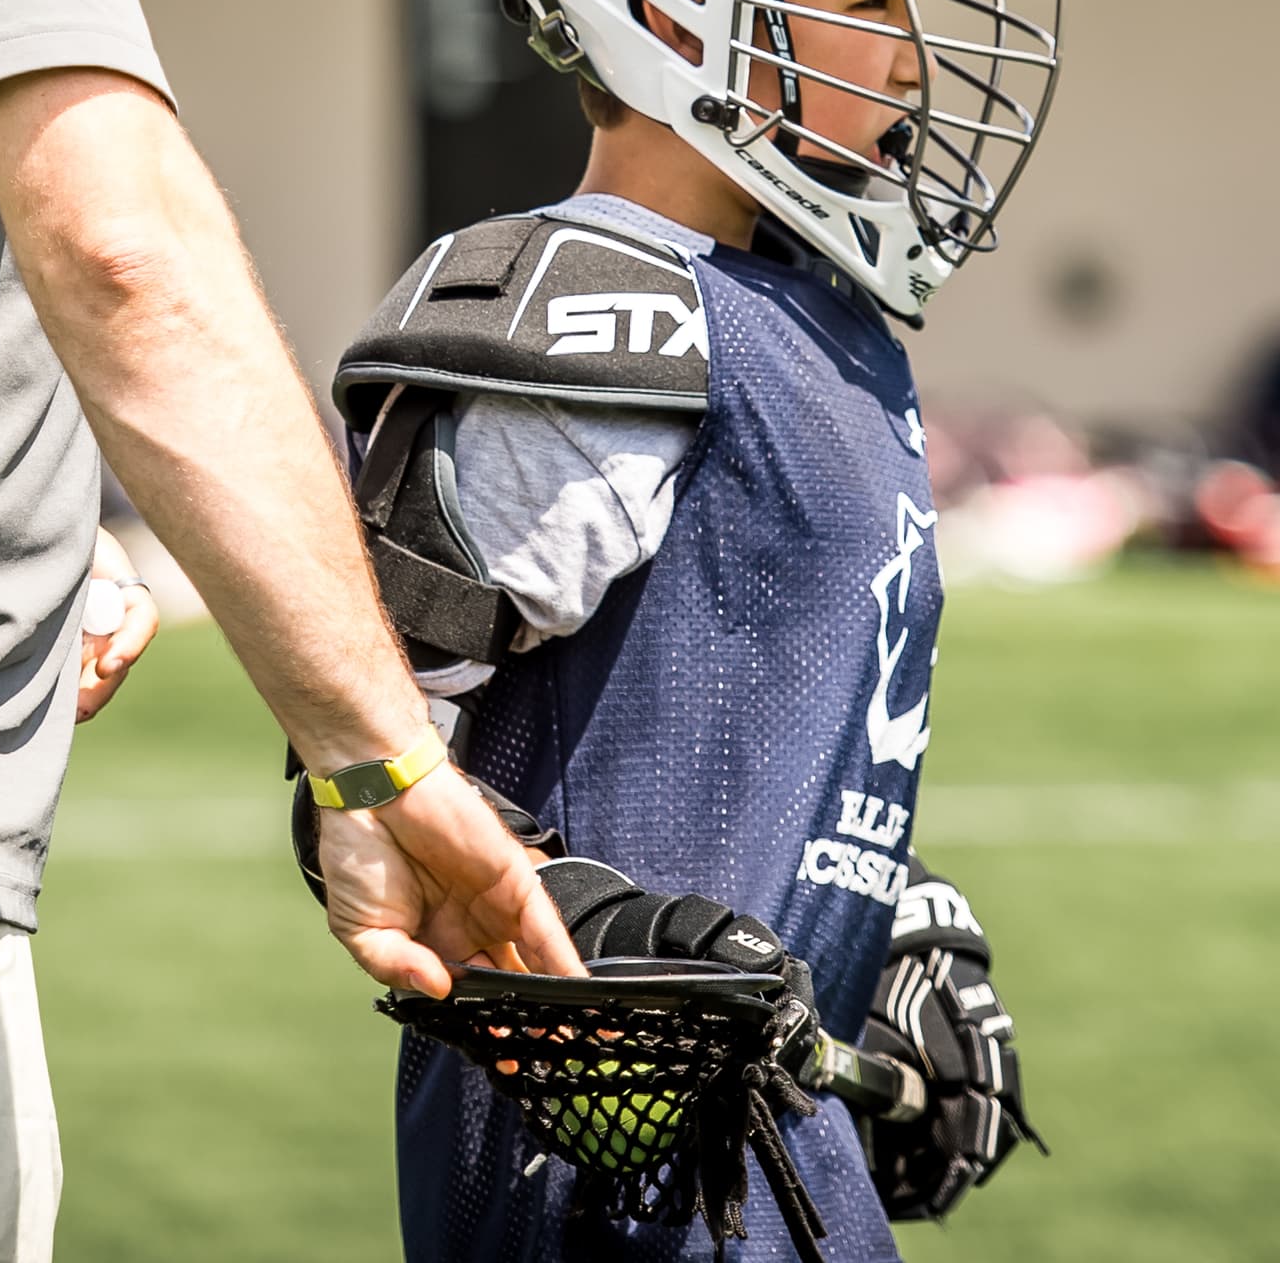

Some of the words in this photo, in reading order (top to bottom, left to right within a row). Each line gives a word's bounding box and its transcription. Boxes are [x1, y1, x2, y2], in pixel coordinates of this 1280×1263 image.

[734, 148, 830, 220] cascade
[545, 292, 710, 362] STX
[727, 929, 776, 955] STX
[891, 881, 984, 940] STX
